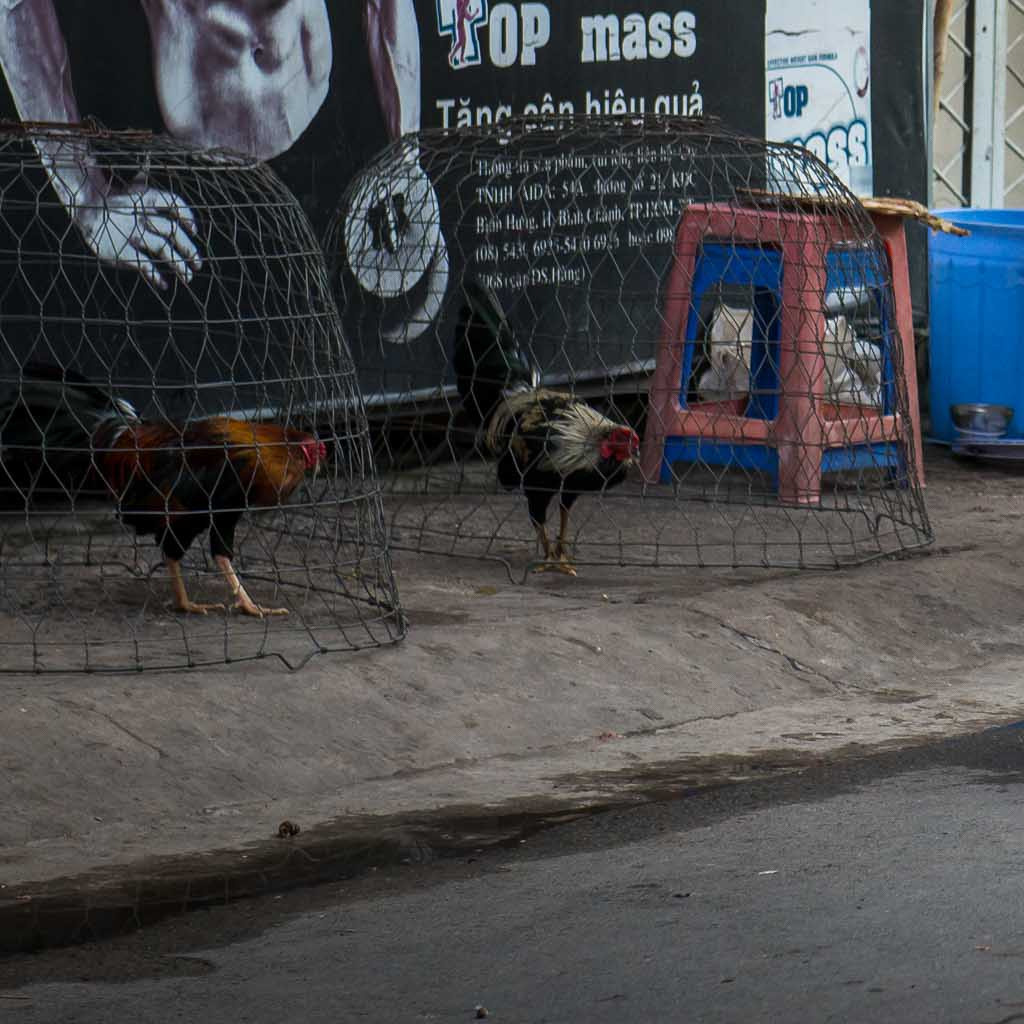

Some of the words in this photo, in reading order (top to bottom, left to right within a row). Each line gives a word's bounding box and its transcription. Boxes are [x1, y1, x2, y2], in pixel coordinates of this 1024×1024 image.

[580, 10, 697, 64] mass
[436, 97, 512, 145] Tăng
[523, 92, 575, 132] cân
[655, 79, 704, 133] quả
